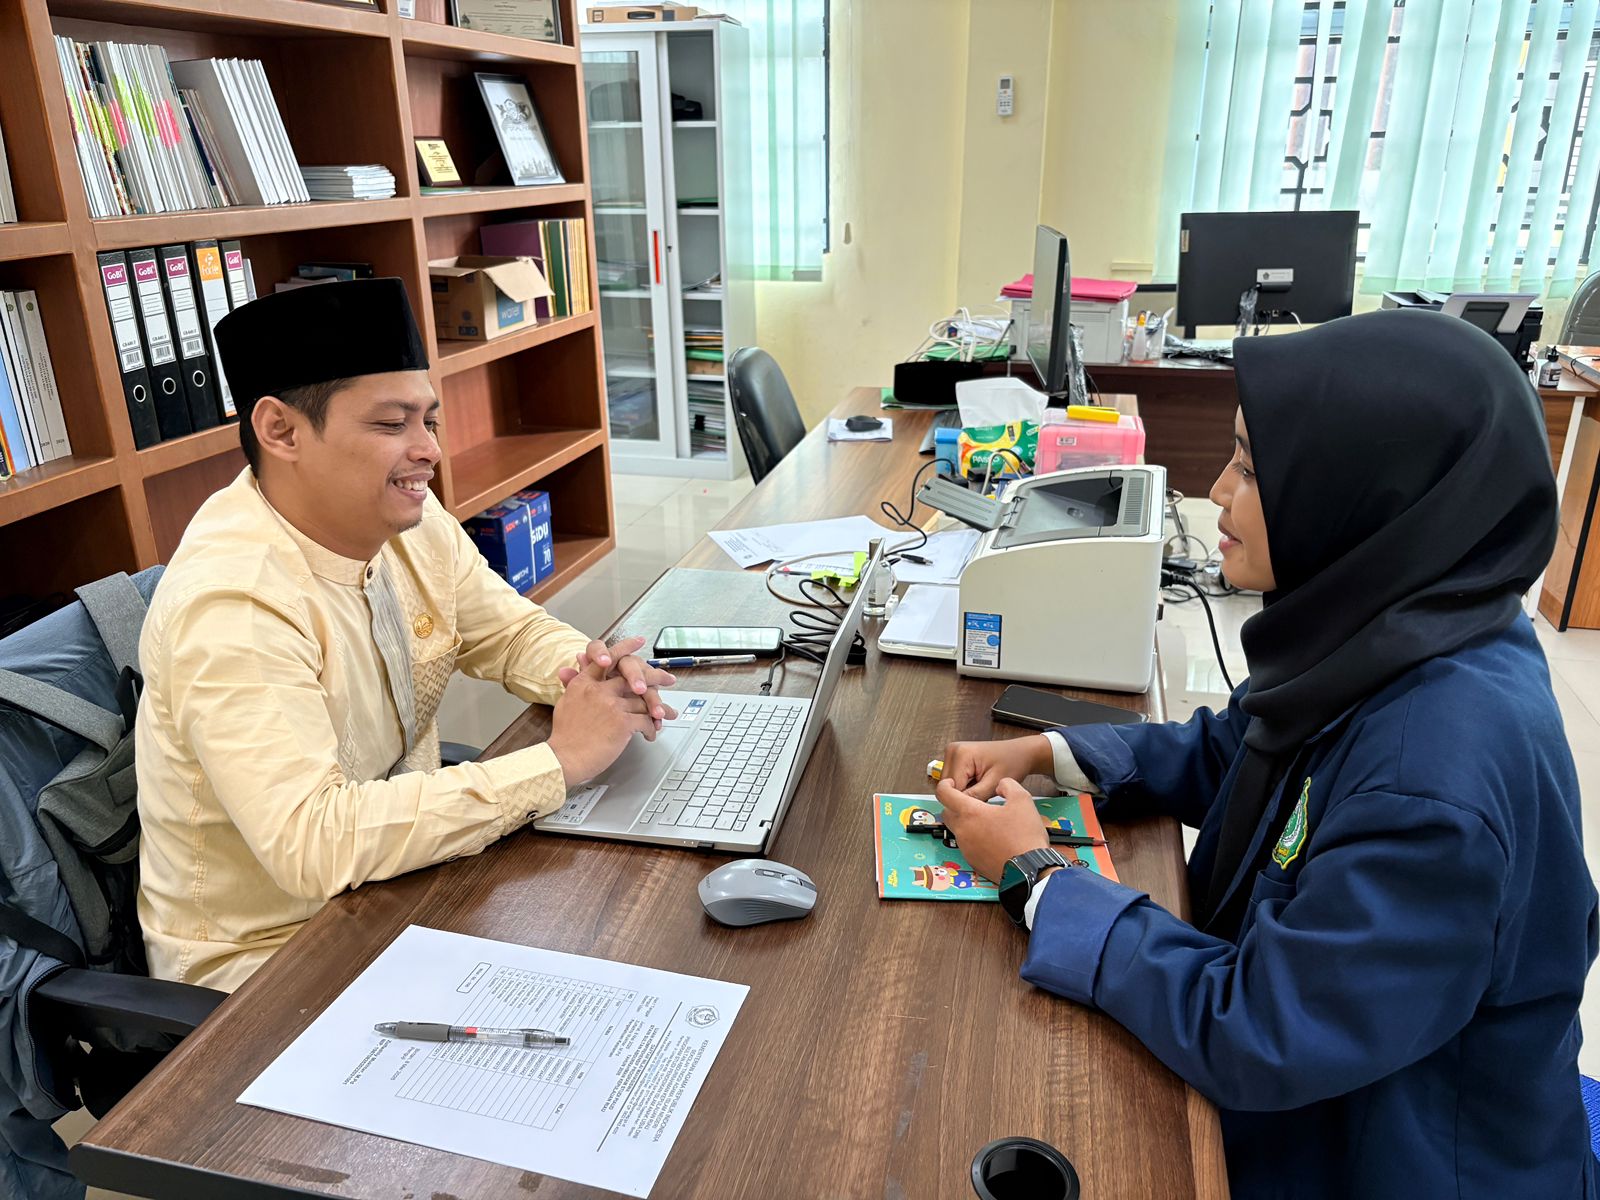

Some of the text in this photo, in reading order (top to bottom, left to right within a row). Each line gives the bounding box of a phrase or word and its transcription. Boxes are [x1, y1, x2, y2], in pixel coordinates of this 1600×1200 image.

[652, 1039, 709, 1142] KEMENTERIAN AGAMA REPUBLIK INDONESIA
